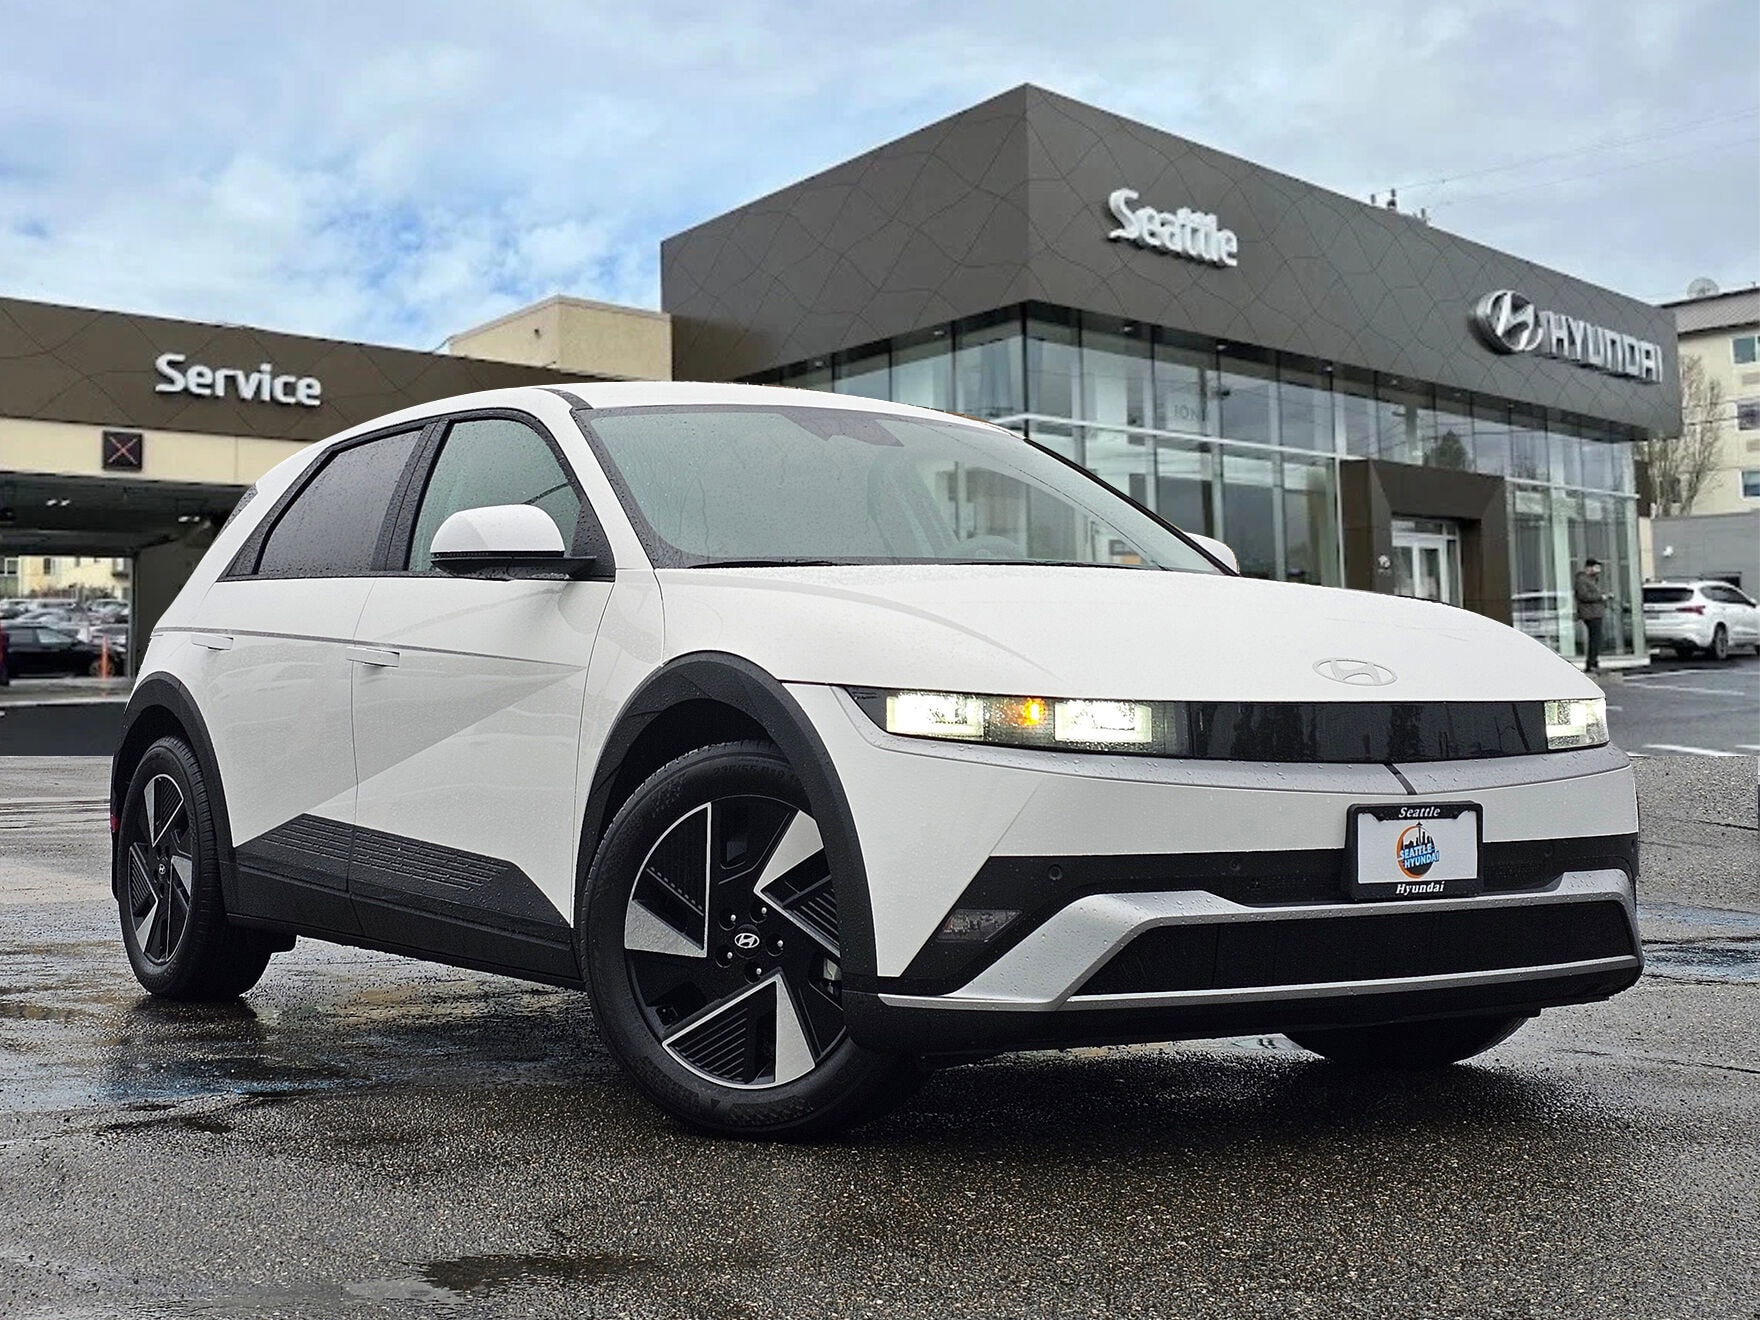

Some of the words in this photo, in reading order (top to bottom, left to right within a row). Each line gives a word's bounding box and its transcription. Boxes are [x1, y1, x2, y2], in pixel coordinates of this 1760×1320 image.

[1109, 188, 1238, 266] Seattle
[1543, 311, 1663, 383] HYUNDAI
[155, 353, 321, 406] Service
[1399, 806, 1441, 818] Seattle
[1400, 843, 1433, 859] SEATTLE
[1404, 849, 1439, 869] HYUNDAI
[1396, 881, 1445, 896] Hyundai
